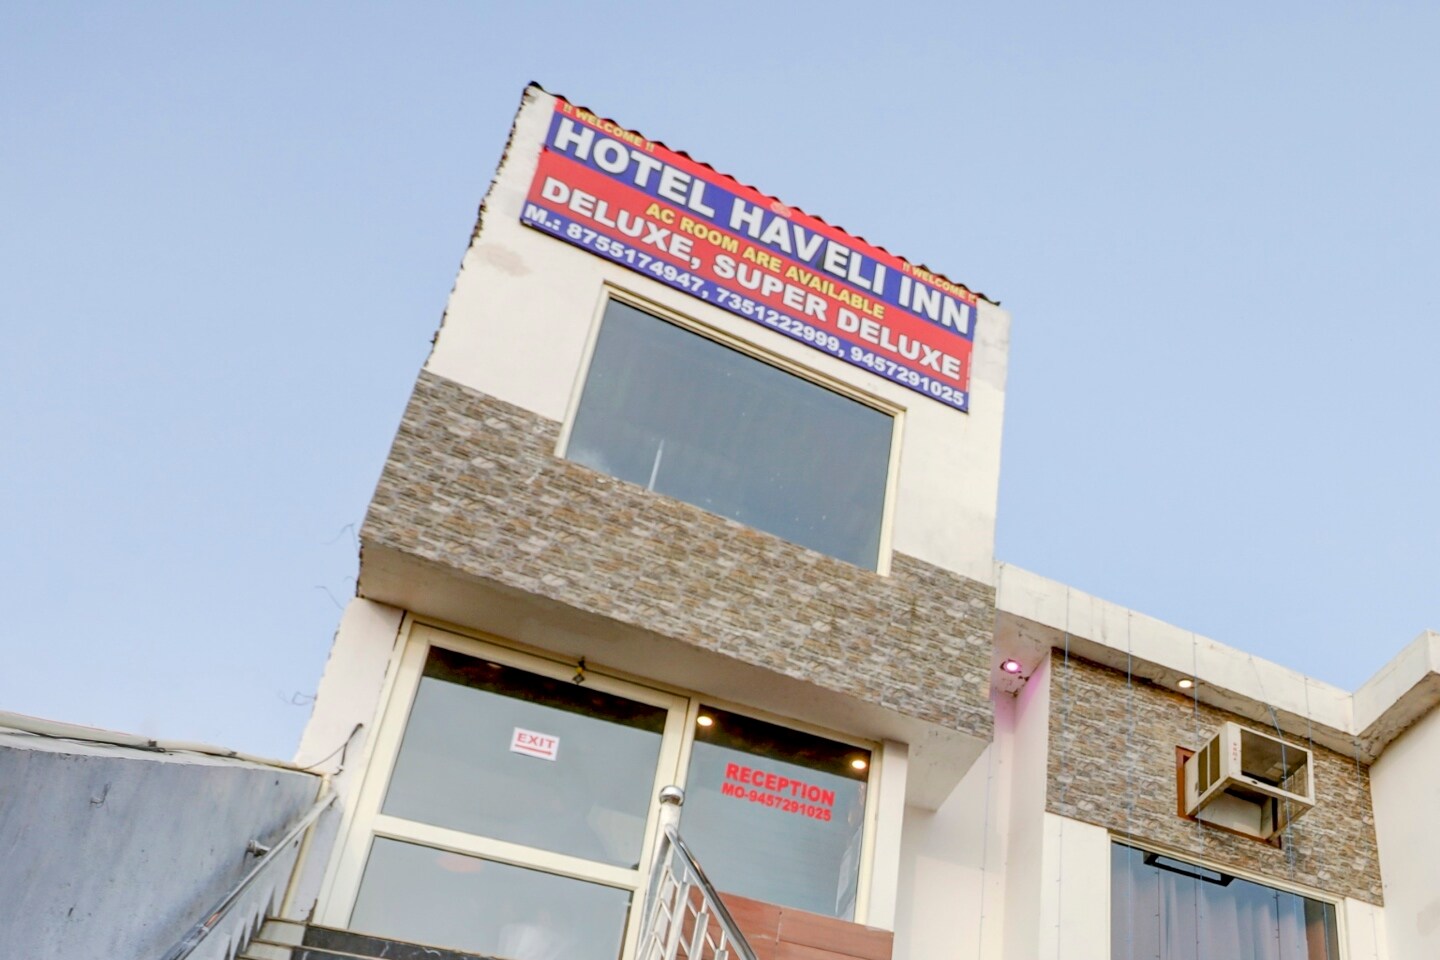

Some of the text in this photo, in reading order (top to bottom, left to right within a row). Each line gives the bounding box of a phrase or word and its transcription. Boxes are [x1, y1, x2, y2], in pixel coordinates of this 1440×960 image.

[575, 109, 644, 148] WELCOME
[554, 117, 970, 335] HOTEL HAVELI INN
[646, 203, 885, 319] AC ROOM ARE AVAILABLE
[541, 176, 961, 380] DELUXE, SUPER DELUXE
[567, 222, 708, 299] 8755174947,
[716, 287, 845, 358] 7351222999,
[850, 346, 965, 406] 9457291025
[516, 732, 556, 749] EXIT
[721, 781, 832, 822] MO-9457291025
[725, 762, 836, 807] RECEPTION
